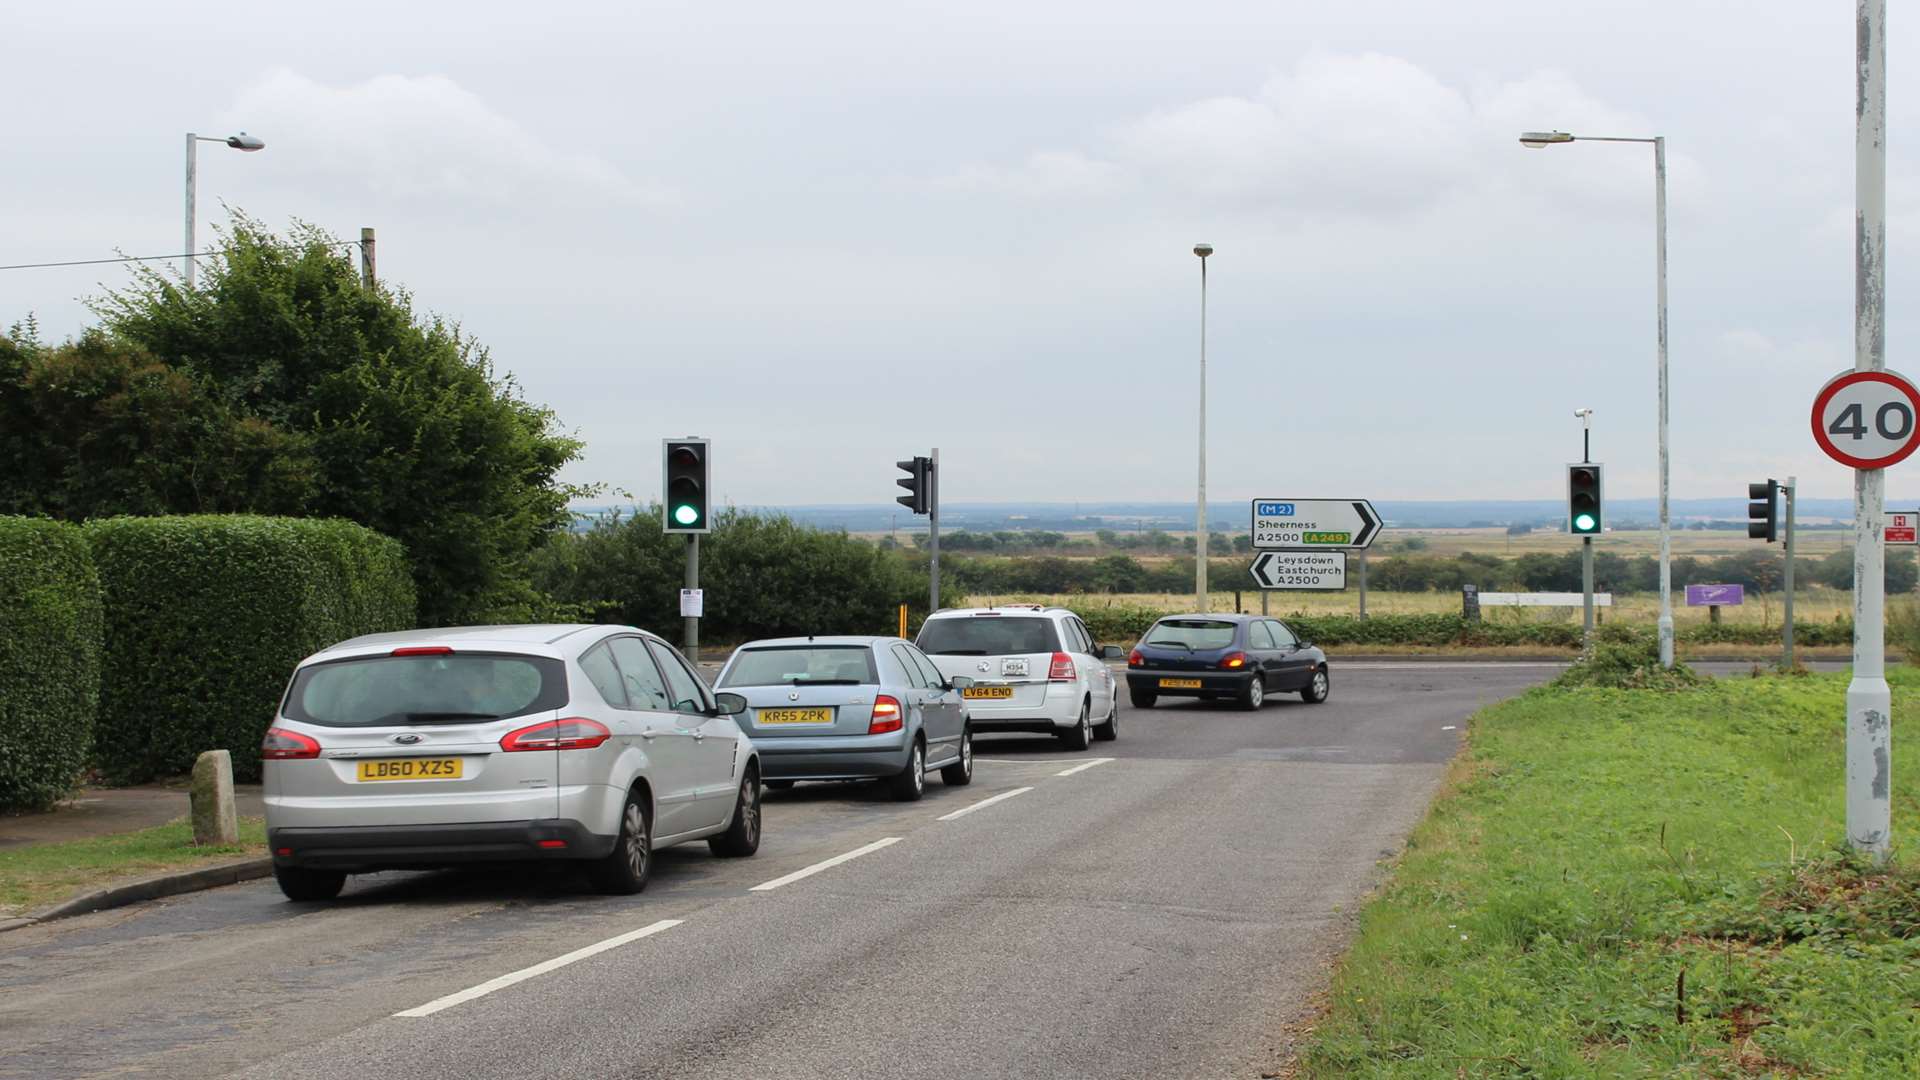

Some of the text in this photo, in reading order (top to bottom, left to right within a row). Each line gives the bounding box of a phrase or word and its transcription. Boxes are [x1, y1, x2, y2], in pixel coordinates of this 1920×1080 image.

[1829, 402, 1913, 440] 40
[1257, 520, 1317, 529] Sheerness
[1257, 533, 1299, 542] A2500
[1278, 556, 1333, 566] Leysdown
[1278, 566, 1341, 575] Eastchurch
[1277, 576, 1320, 585] A2500
[764, 711, 825, 722] KR55 ZPK
[364, 760, 455, 778] LD60 XZS
